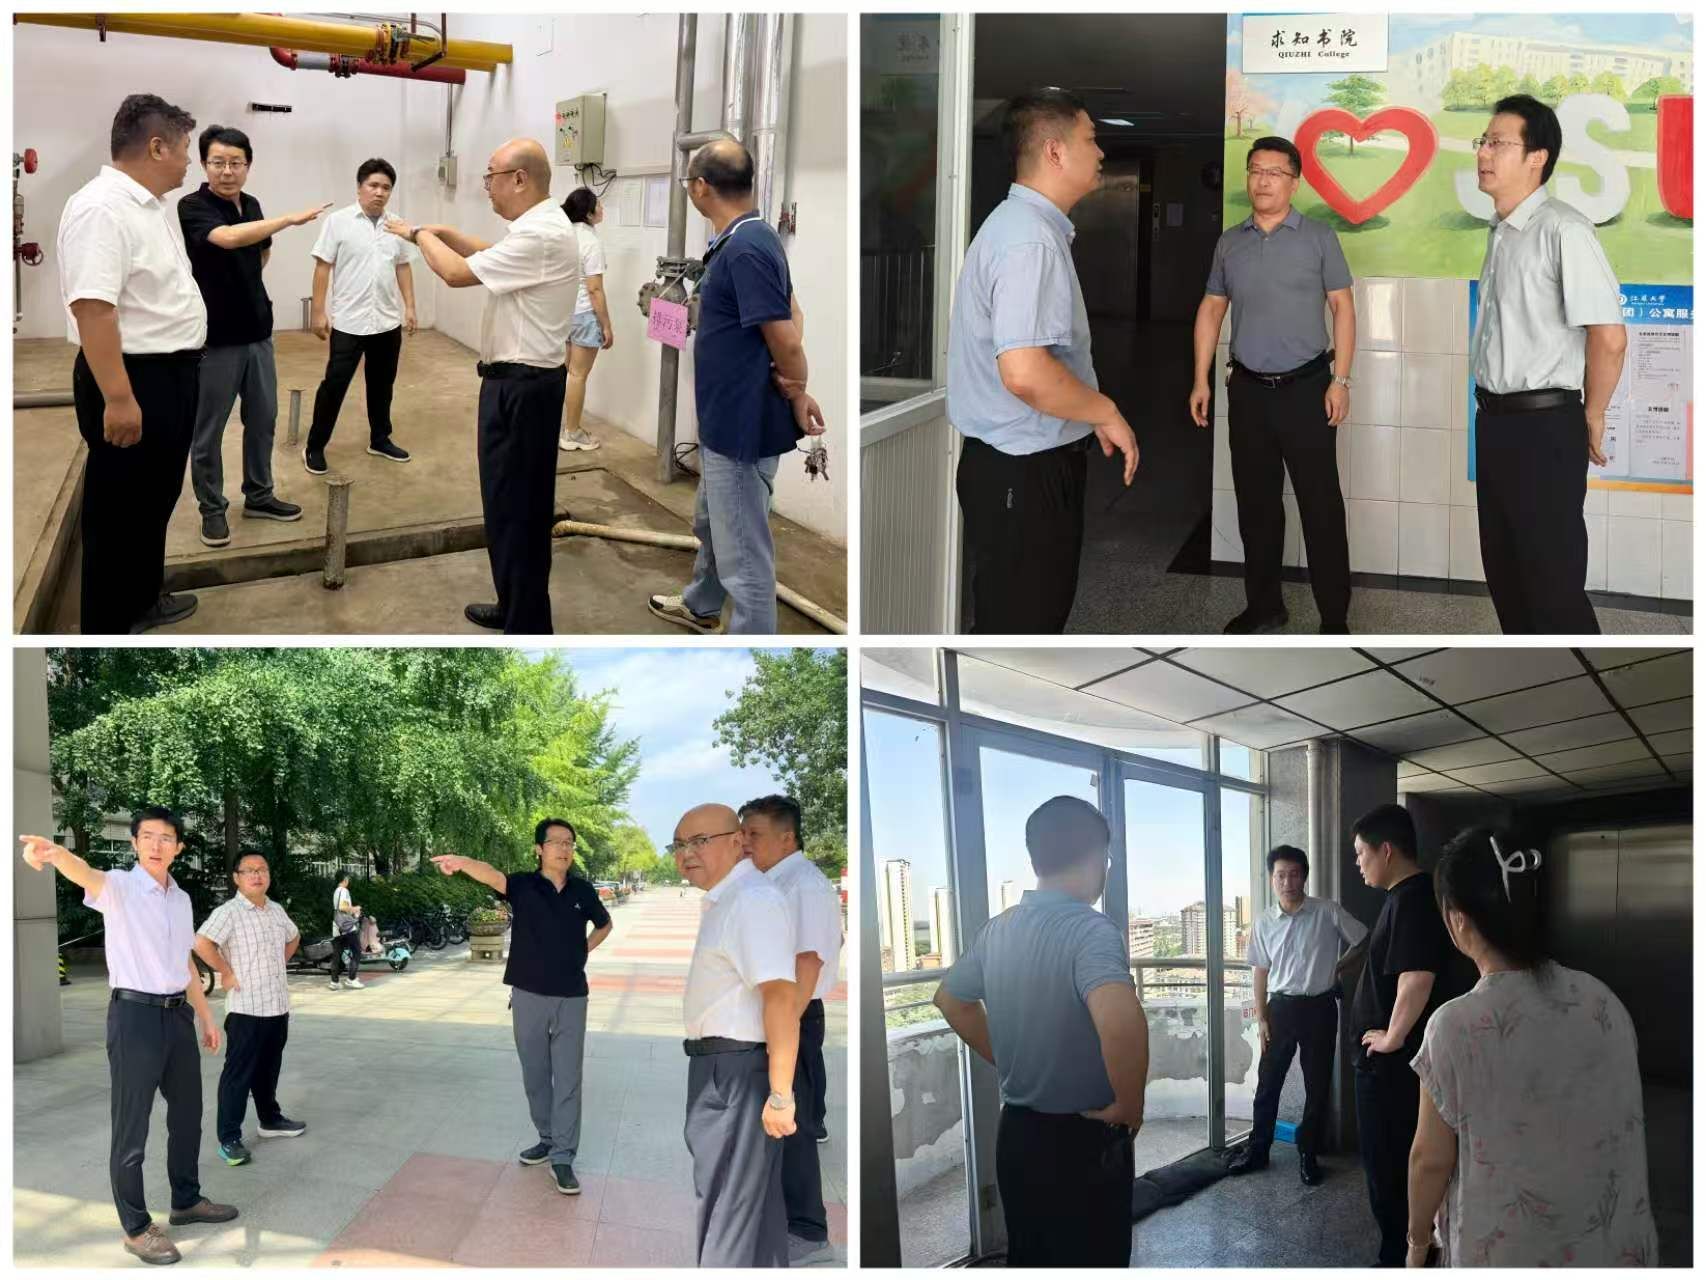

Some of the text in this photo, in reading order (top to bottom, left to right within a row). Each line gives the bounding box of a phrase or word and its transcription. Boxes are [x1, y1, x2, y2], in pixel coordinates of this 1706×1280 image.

[1271, 28, 1358, 49] 求知书院
[1278, 50, 1350, 59] QIUZHI College
